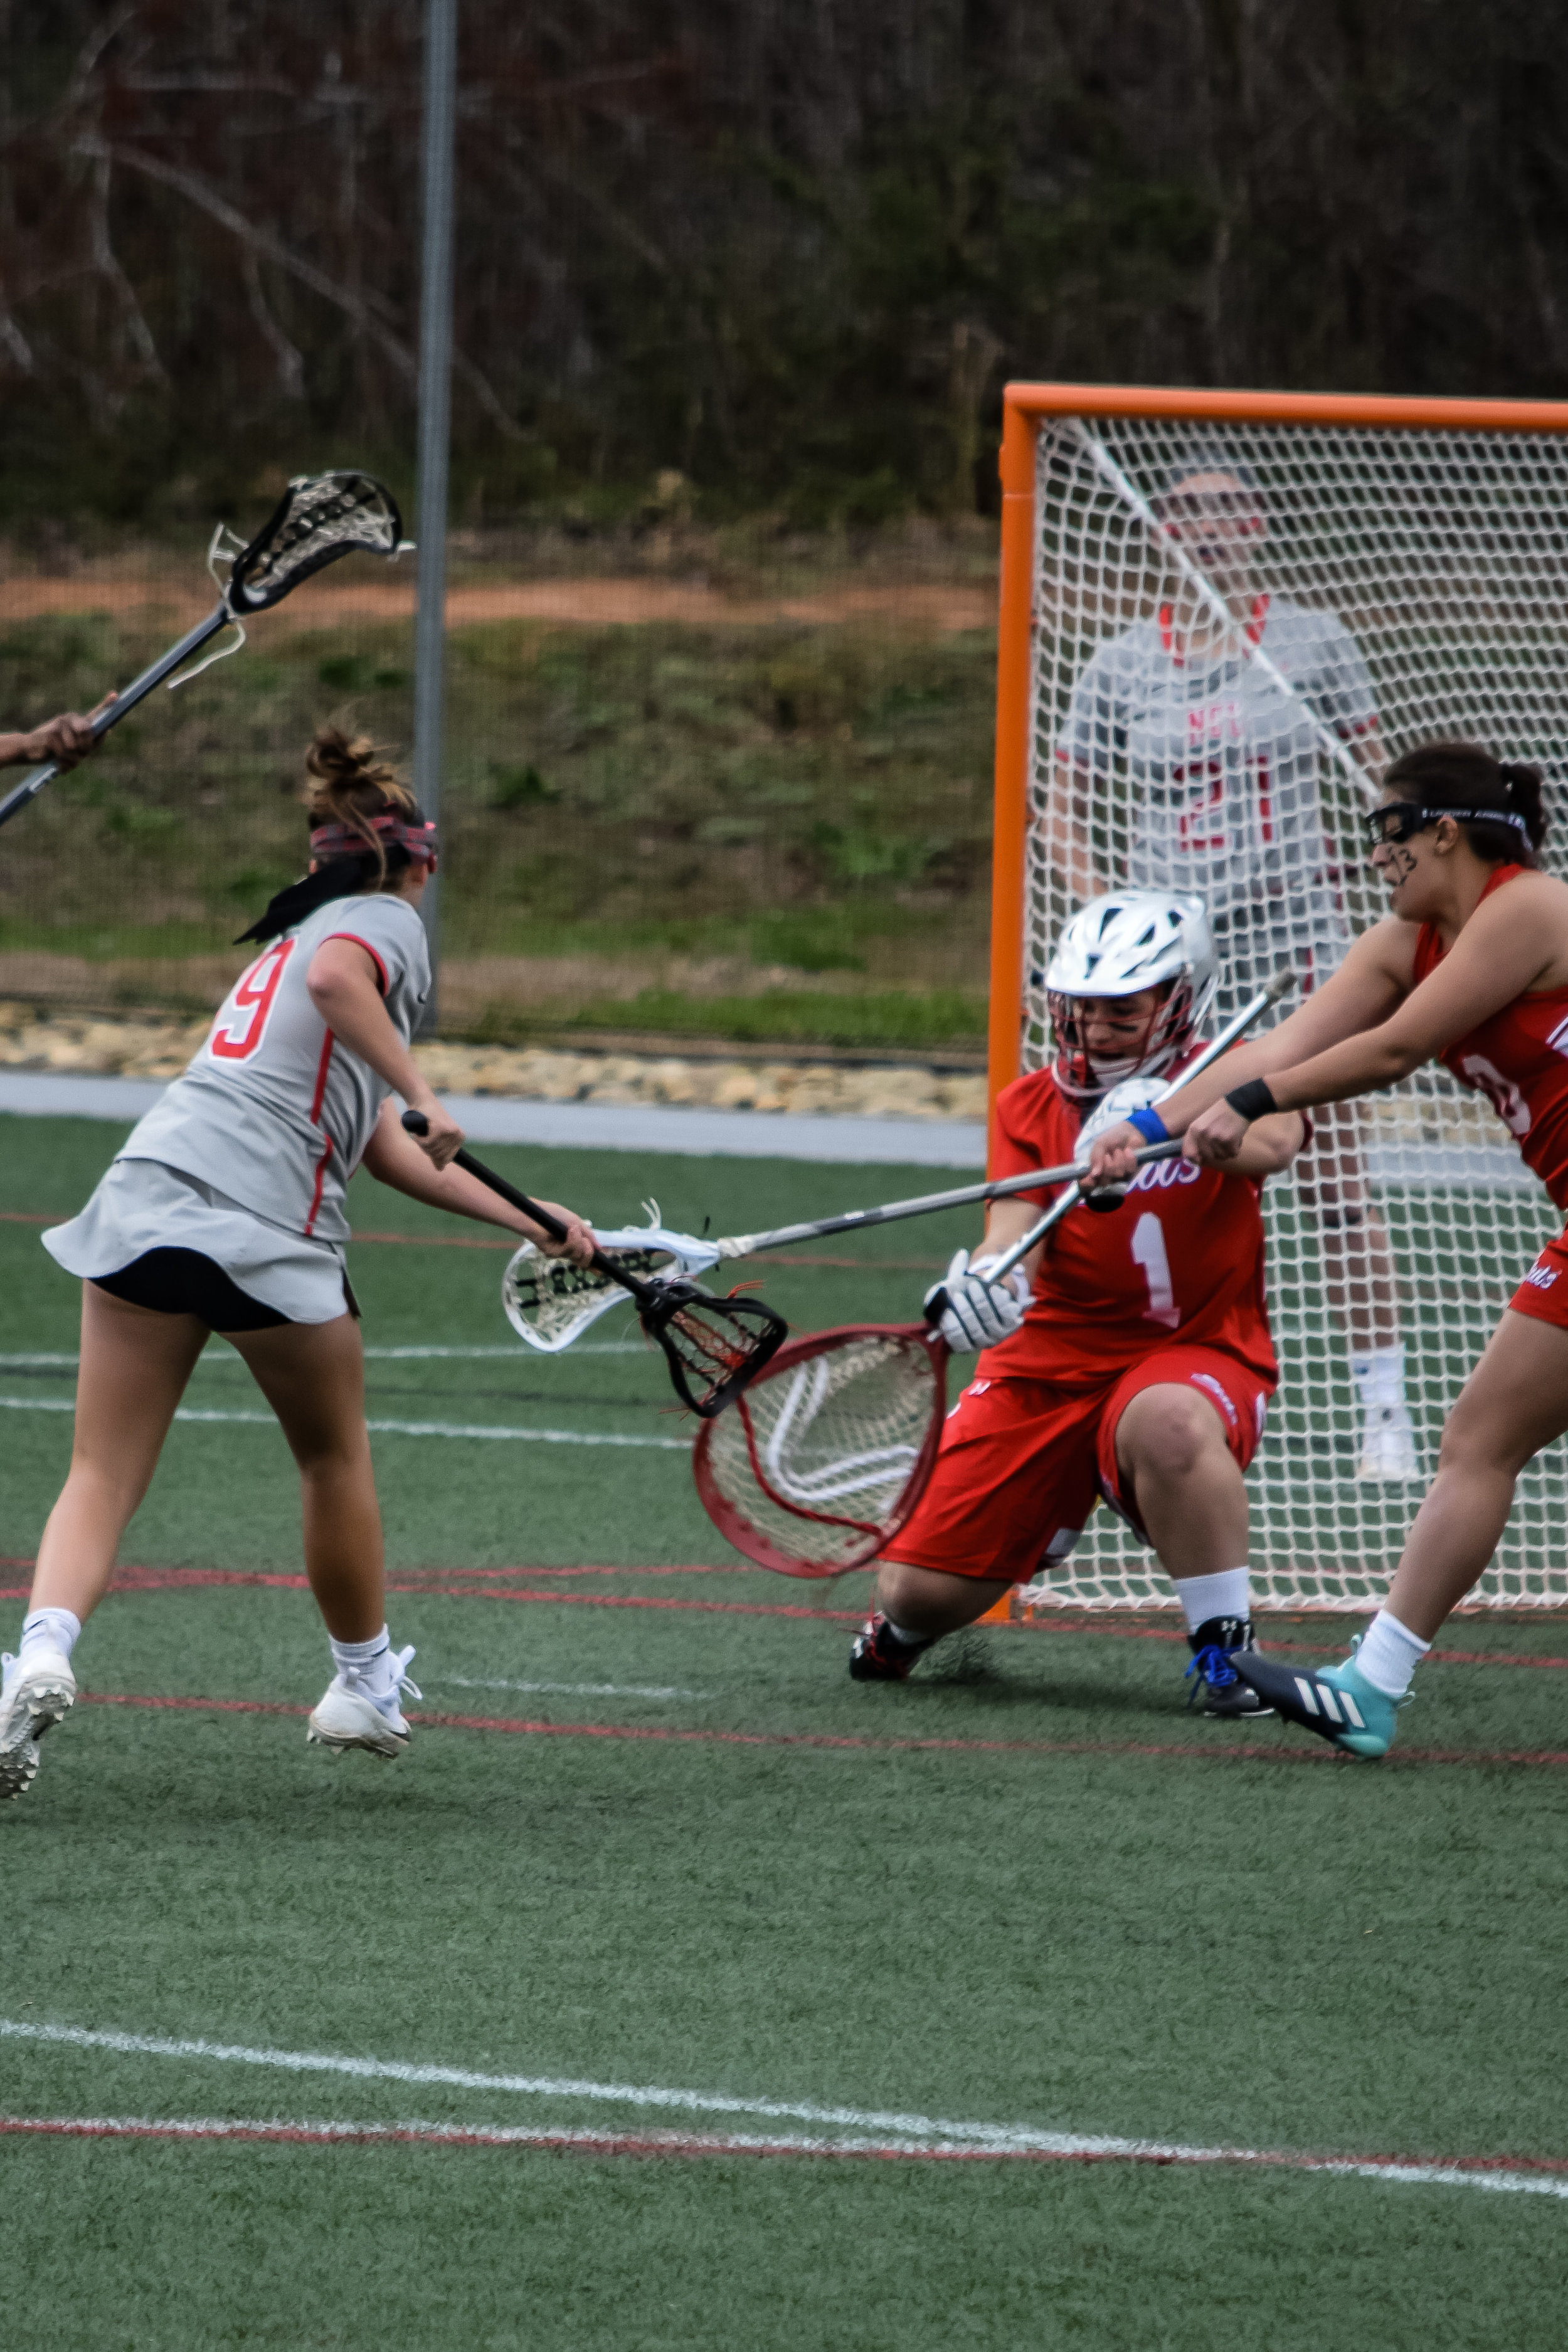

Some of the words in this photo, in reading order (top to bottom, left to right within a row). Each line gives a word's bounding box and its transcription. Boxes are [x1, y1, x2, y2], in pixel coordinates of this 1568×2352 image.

[1172, 755, 1273, 852] 21
[209, 938, 297, 1062] 9
[1130, 1212, 1181, 1329] 1
